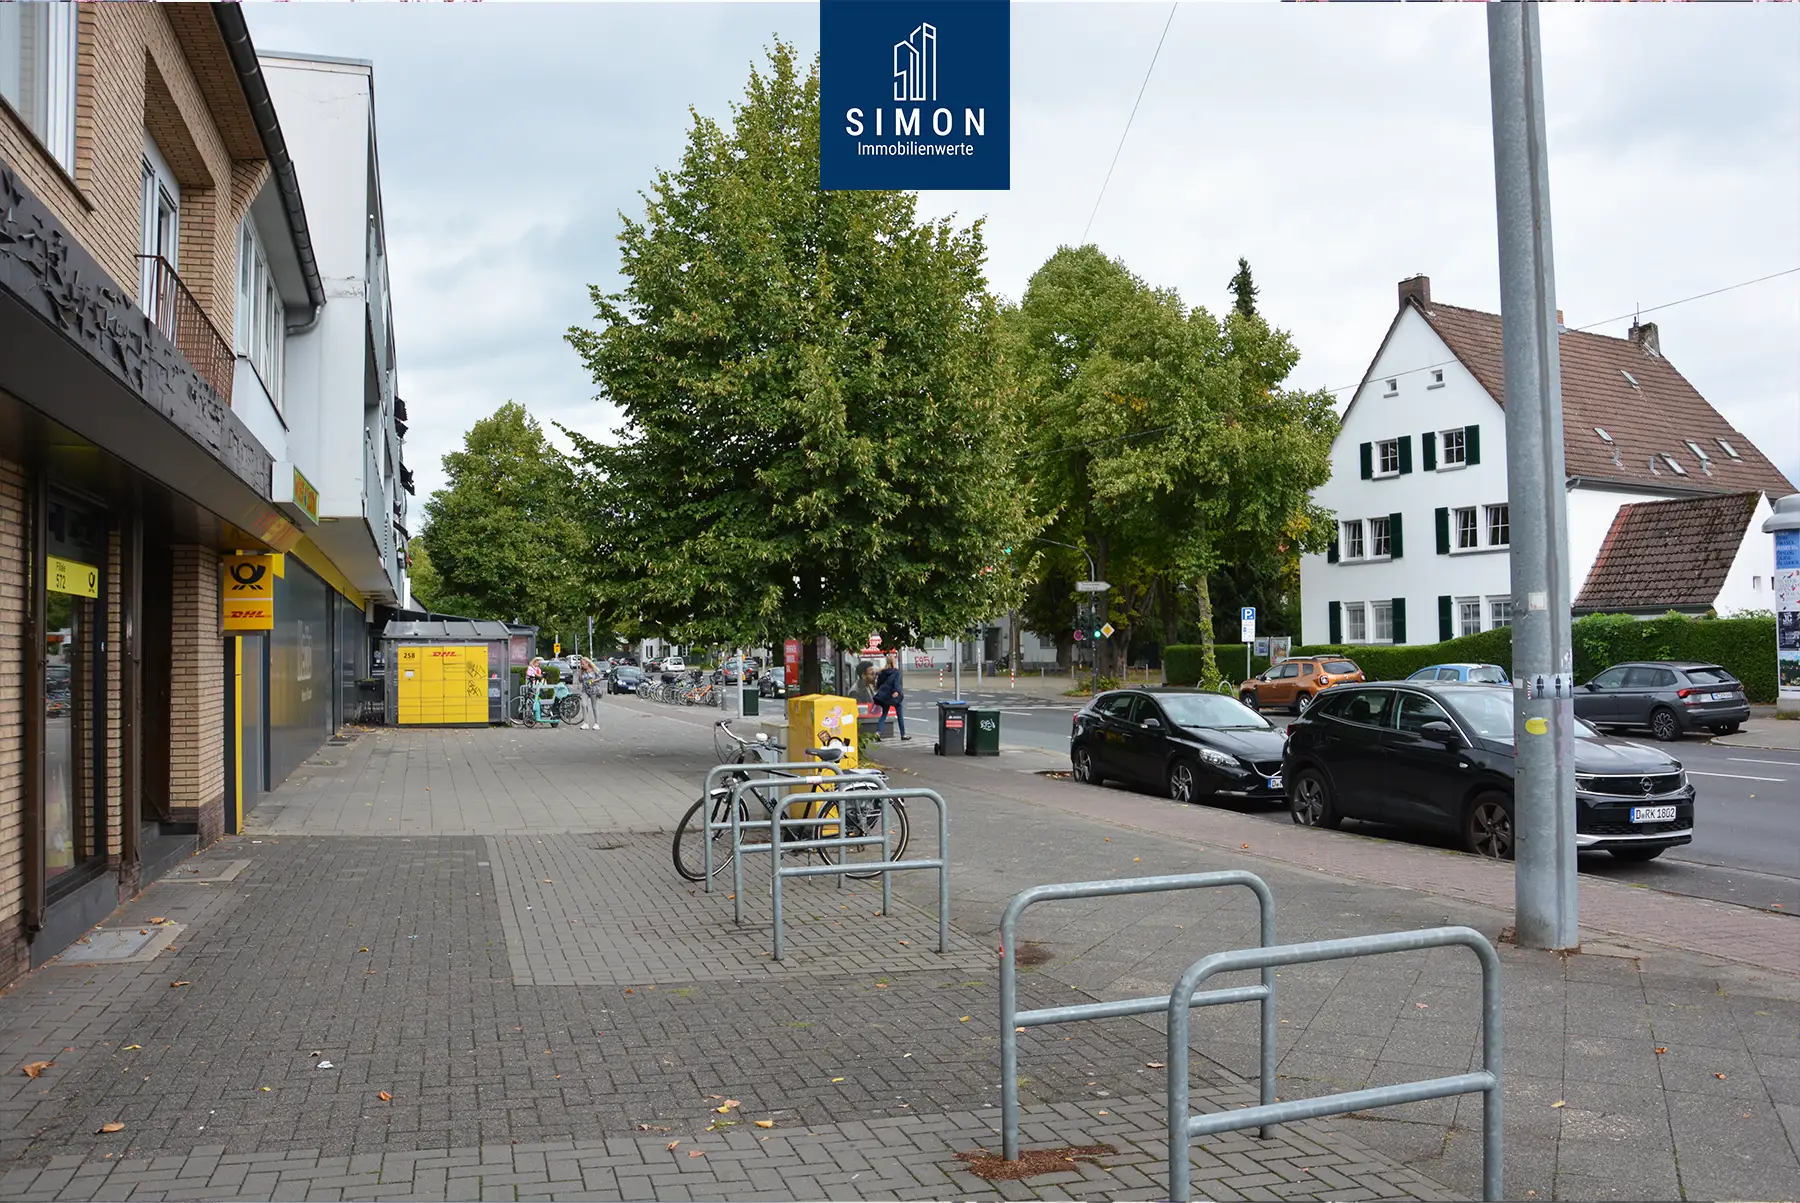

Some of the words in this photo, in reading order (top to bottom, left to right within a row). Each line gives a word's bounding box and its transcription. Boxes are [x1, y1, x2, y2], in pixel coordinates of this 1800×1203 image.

[56, 573, 66, 589] 572
[230, 610, 265, 618] DHL
[1244, 609, 1253, 620] P
[1645, 808, 1656, 819] RK
[1656, 807, 1675, 819] 1802
